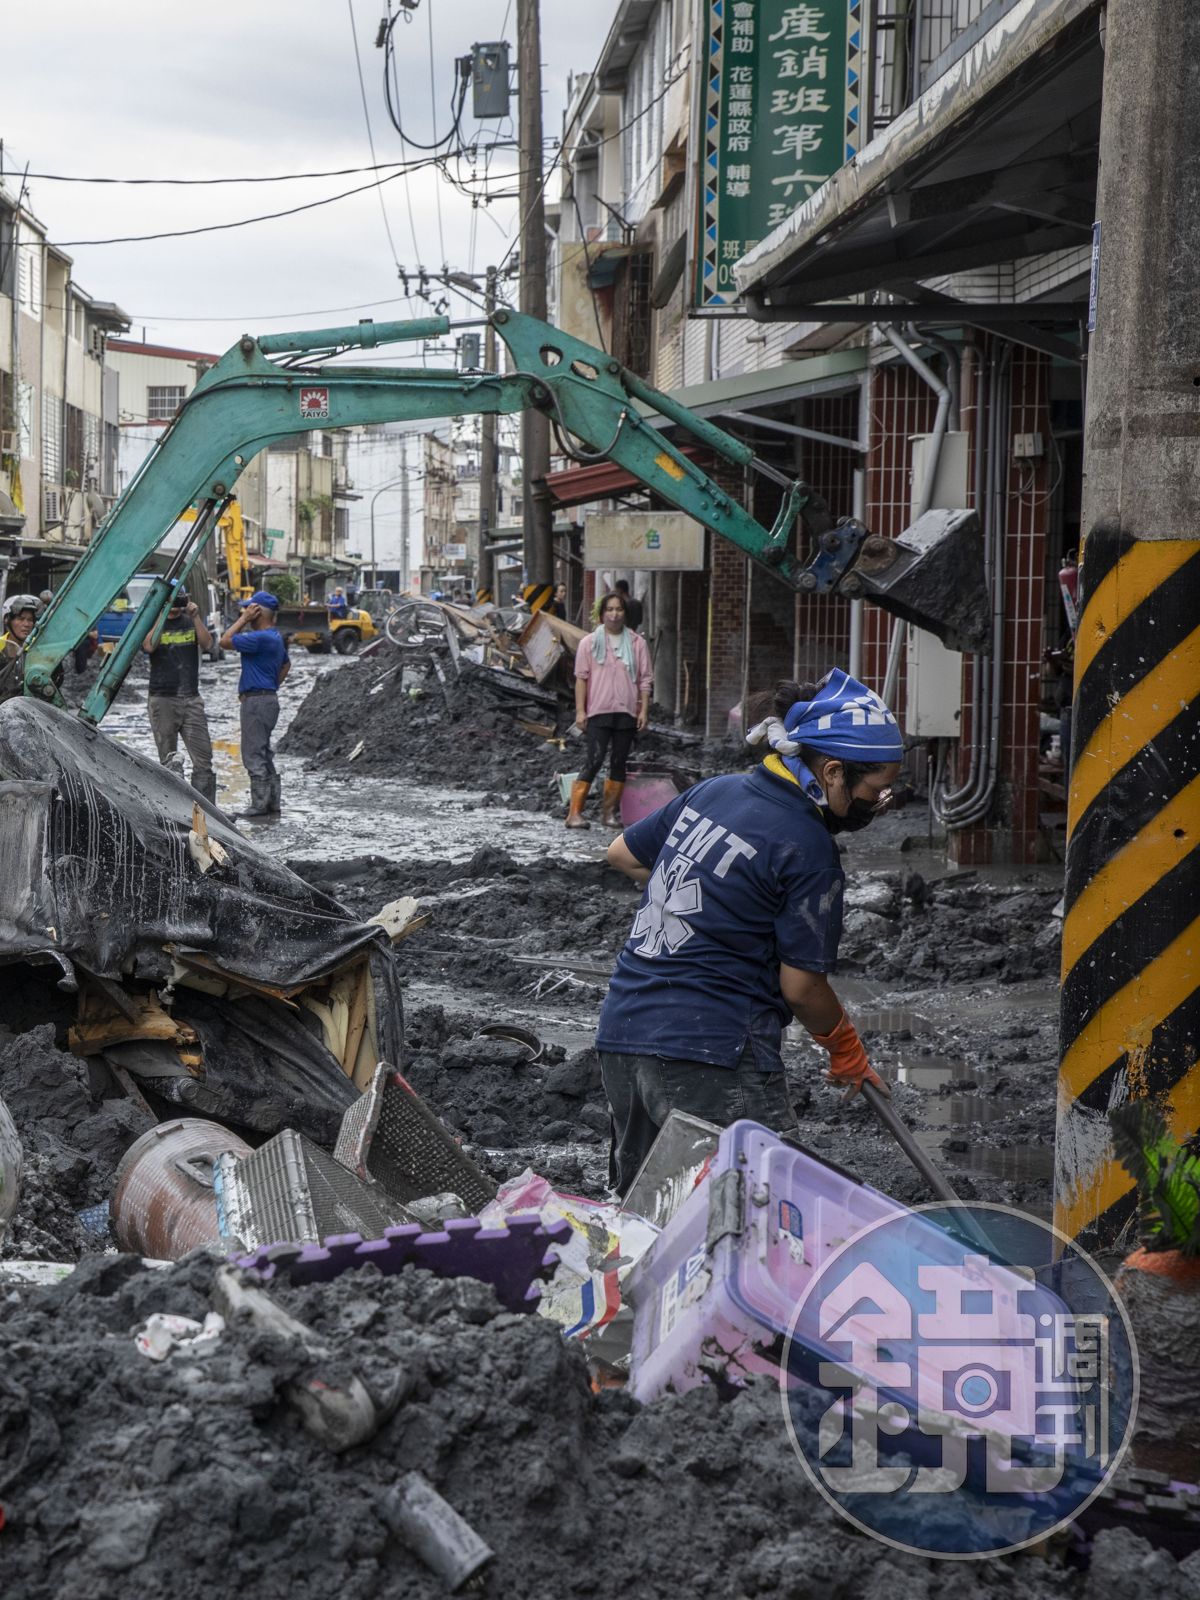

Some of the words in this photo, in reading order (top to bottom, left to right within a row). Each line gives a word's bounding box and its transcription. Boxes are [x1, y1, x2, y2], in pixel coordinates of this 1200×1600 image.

[730, 0, 755, 53] 會補助
[727, 66, 753, 152] 花蓮縣政府
[726, 164, 751, 197] 輔導
[665, 805, 758, 878] EMT
